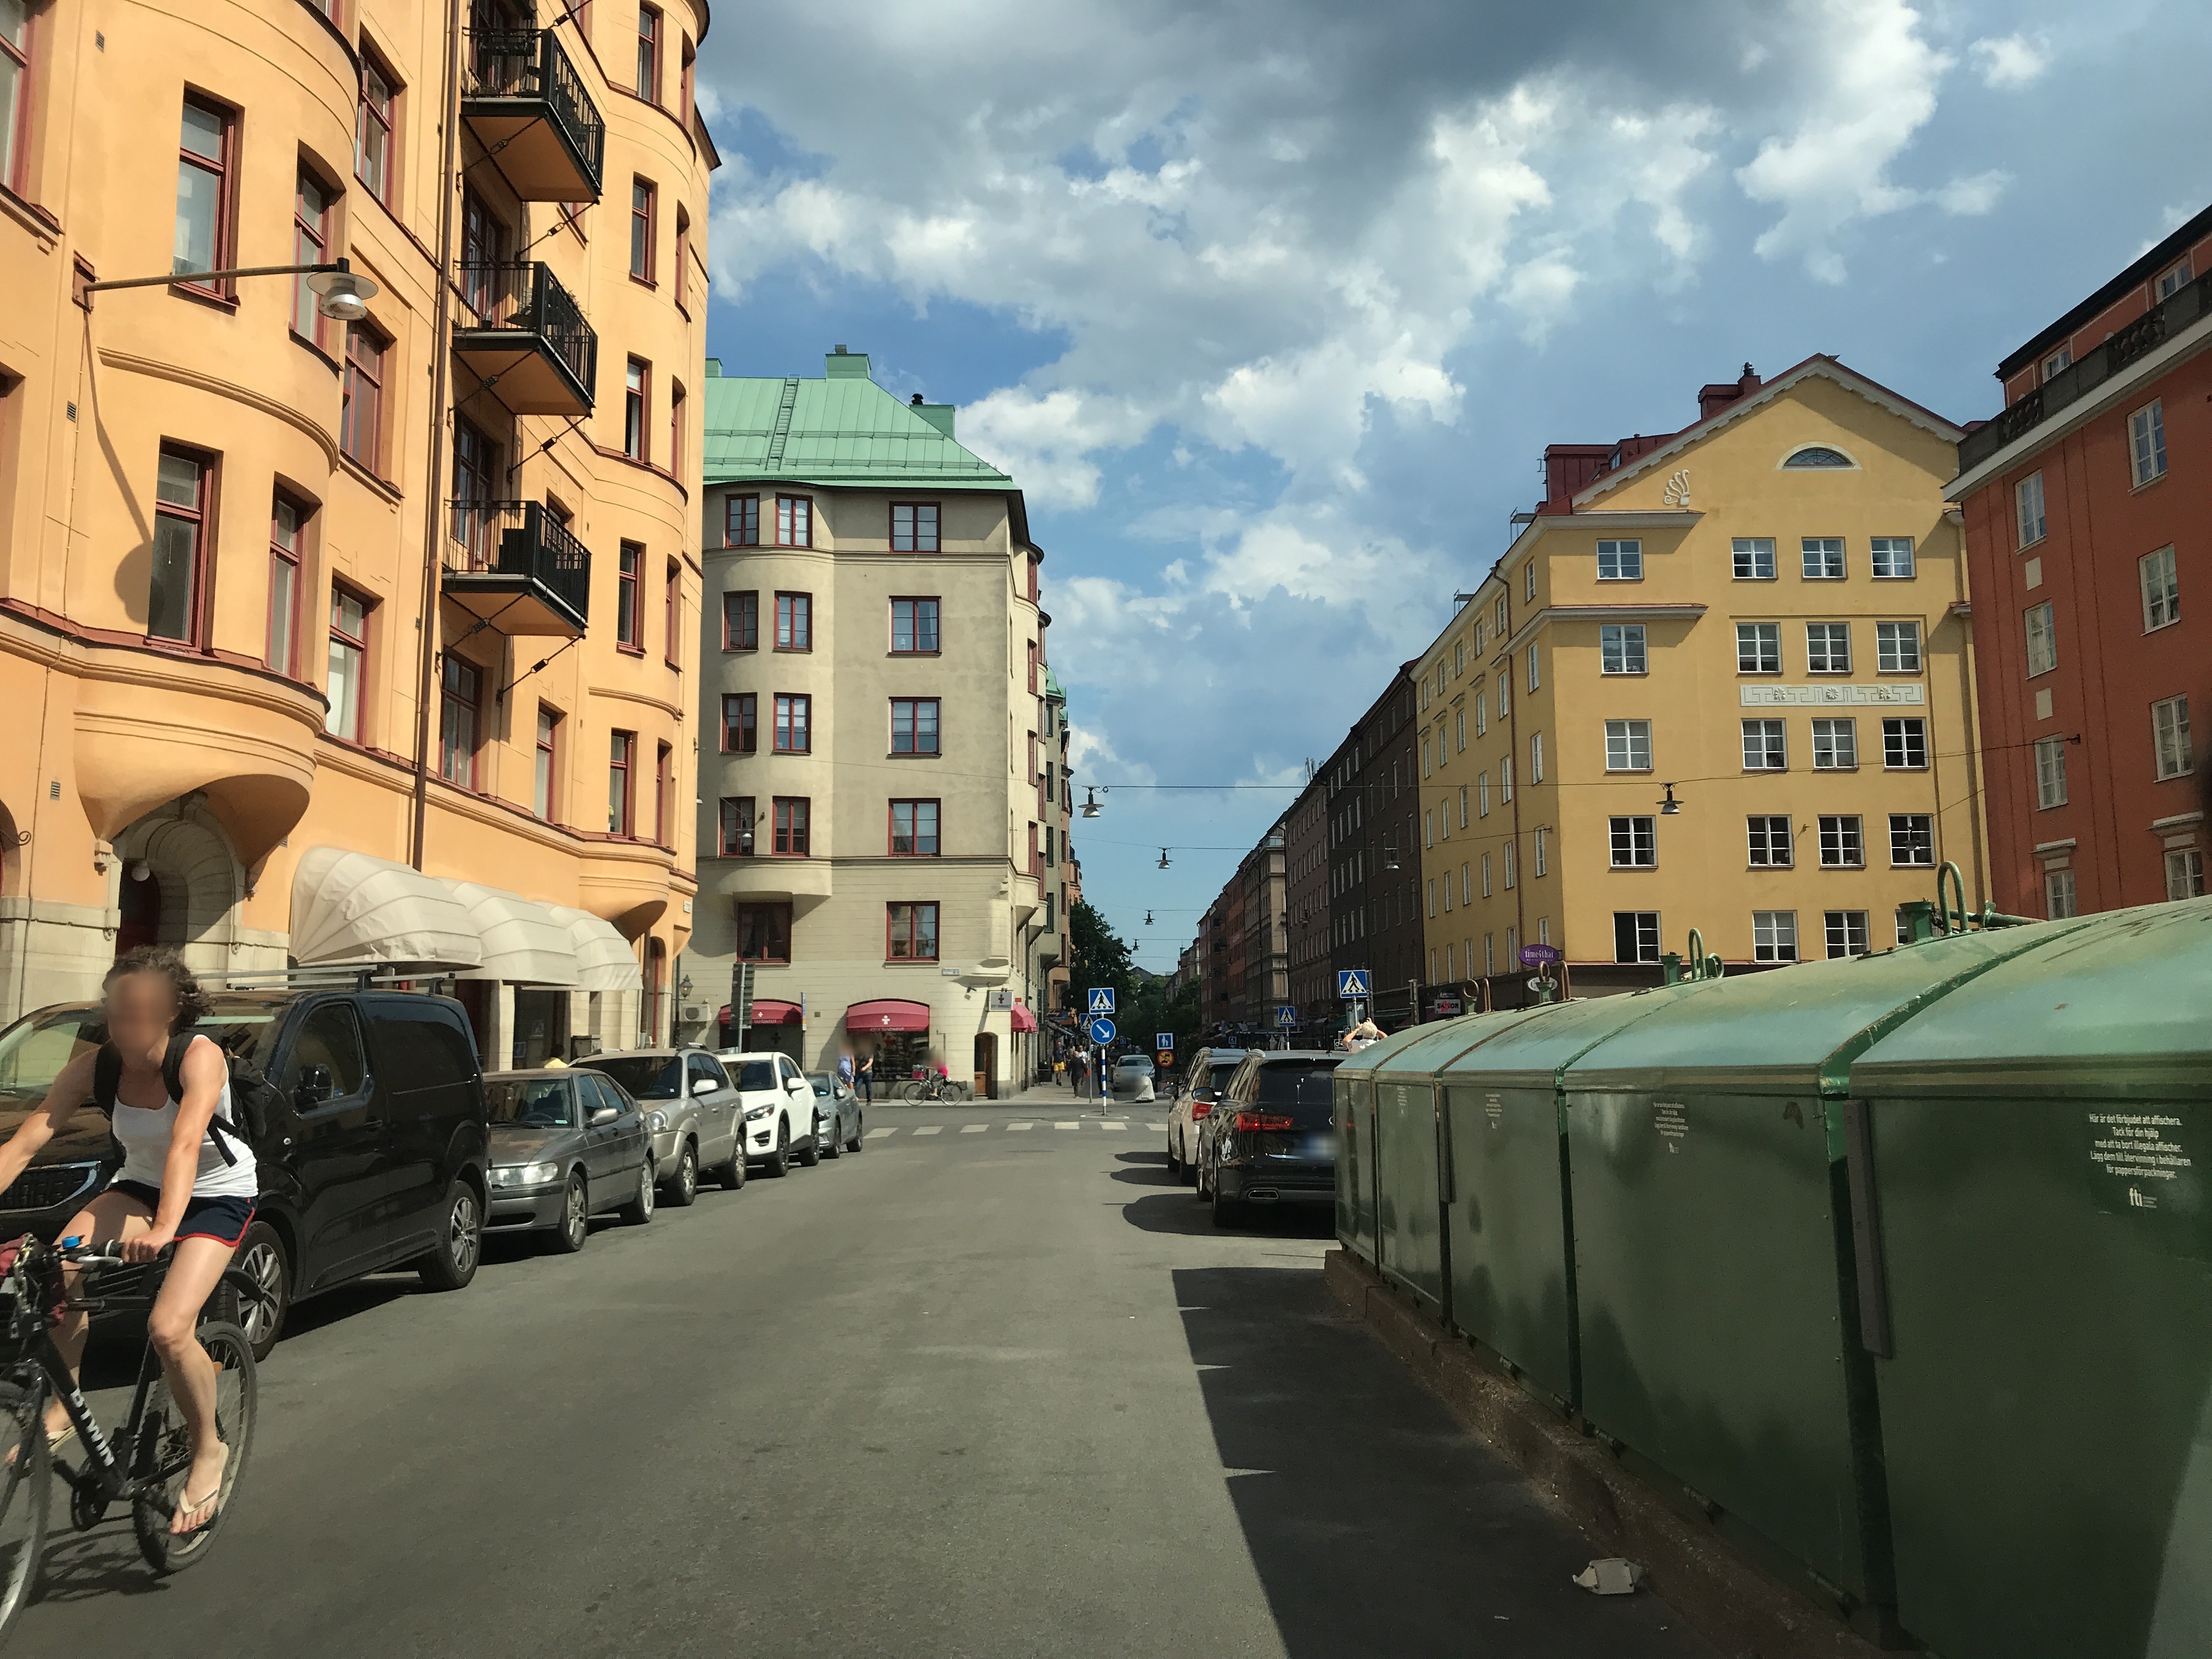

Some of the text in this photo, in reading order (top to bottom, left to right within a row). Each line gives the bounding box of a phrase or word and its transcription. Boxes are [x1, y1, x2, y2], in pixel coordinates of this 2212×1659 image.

[1525, 950, 1554, 958] time4thai
[2089, 1113, 2099, 1122] Här
[2100, 1113, 2106, 1123] är
[2107, 1114, 2116, 1124] det
[2116, 1114, 2142, 1126] förbjudet
[2142, 1115, 2151, 1124] att
[2112, 1126, 2126, 1136] Tack
[2135, 1127, 2144, 1137] din
[2144, 1127, 2159, 1140] hjälp
[2095, 1139, 2107, 1148] med
[2107, 1139, 2115, 1148] att
[2115, 1140, 2121, 1149] ta
[2121, 1139, 2134, 1149] bort
[2134, 1140, 2155, 1153] illegala
[2090, 1150, 2103, 1163] Lägg
[2103, 1151, 2116, 1161] dem
[2116, 1152, 2124, 1161] till
[2124, 1151, 2155, 1166] återvinning
[2159, 1154, 2192, 1166] behållaren
[2106, 1164, 2114, 1173] för
[2129, 1187, 2143, 1207] fti
